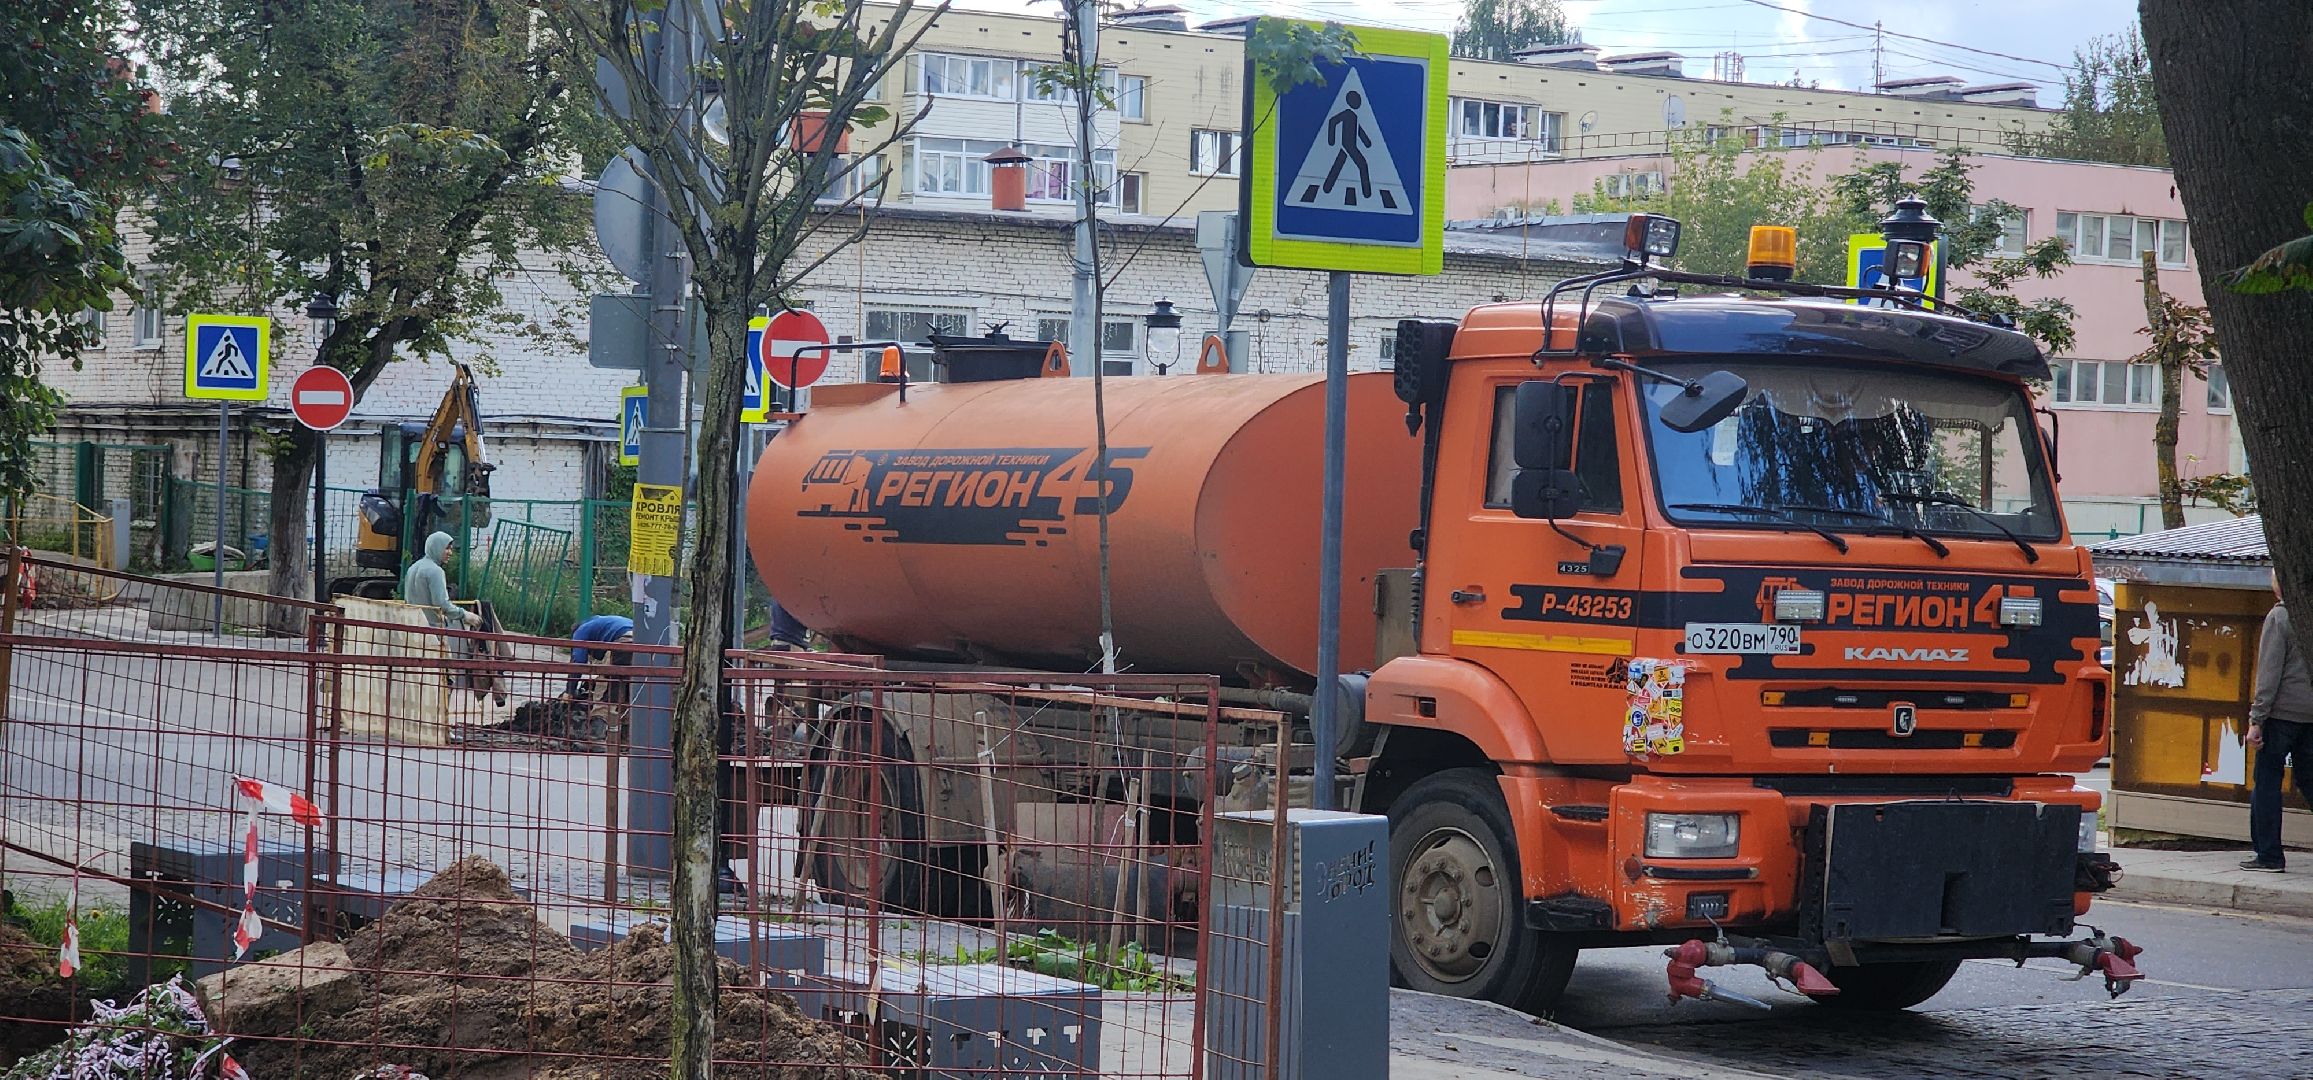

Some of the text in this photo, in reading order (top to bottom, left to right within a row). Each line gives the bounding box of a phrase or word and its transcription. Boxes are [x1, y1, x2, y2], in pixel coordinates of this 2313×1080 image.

[892, 454, 1050, 468] ЗАВОД ДОРОЖНОЙ ТЕХНИКИ
[876, 471, 1040, 508] РЕГИОН
[1830, 578, 1970, 592] ЗАВОД ДОРОЖНОЙ ТЕХНИКИ
[1826, 584, 2035, 629] РЕГИОН 4
[1769, 627, 1796, 644] 790
[1844, 647, 1969, 662] KAMAZ
